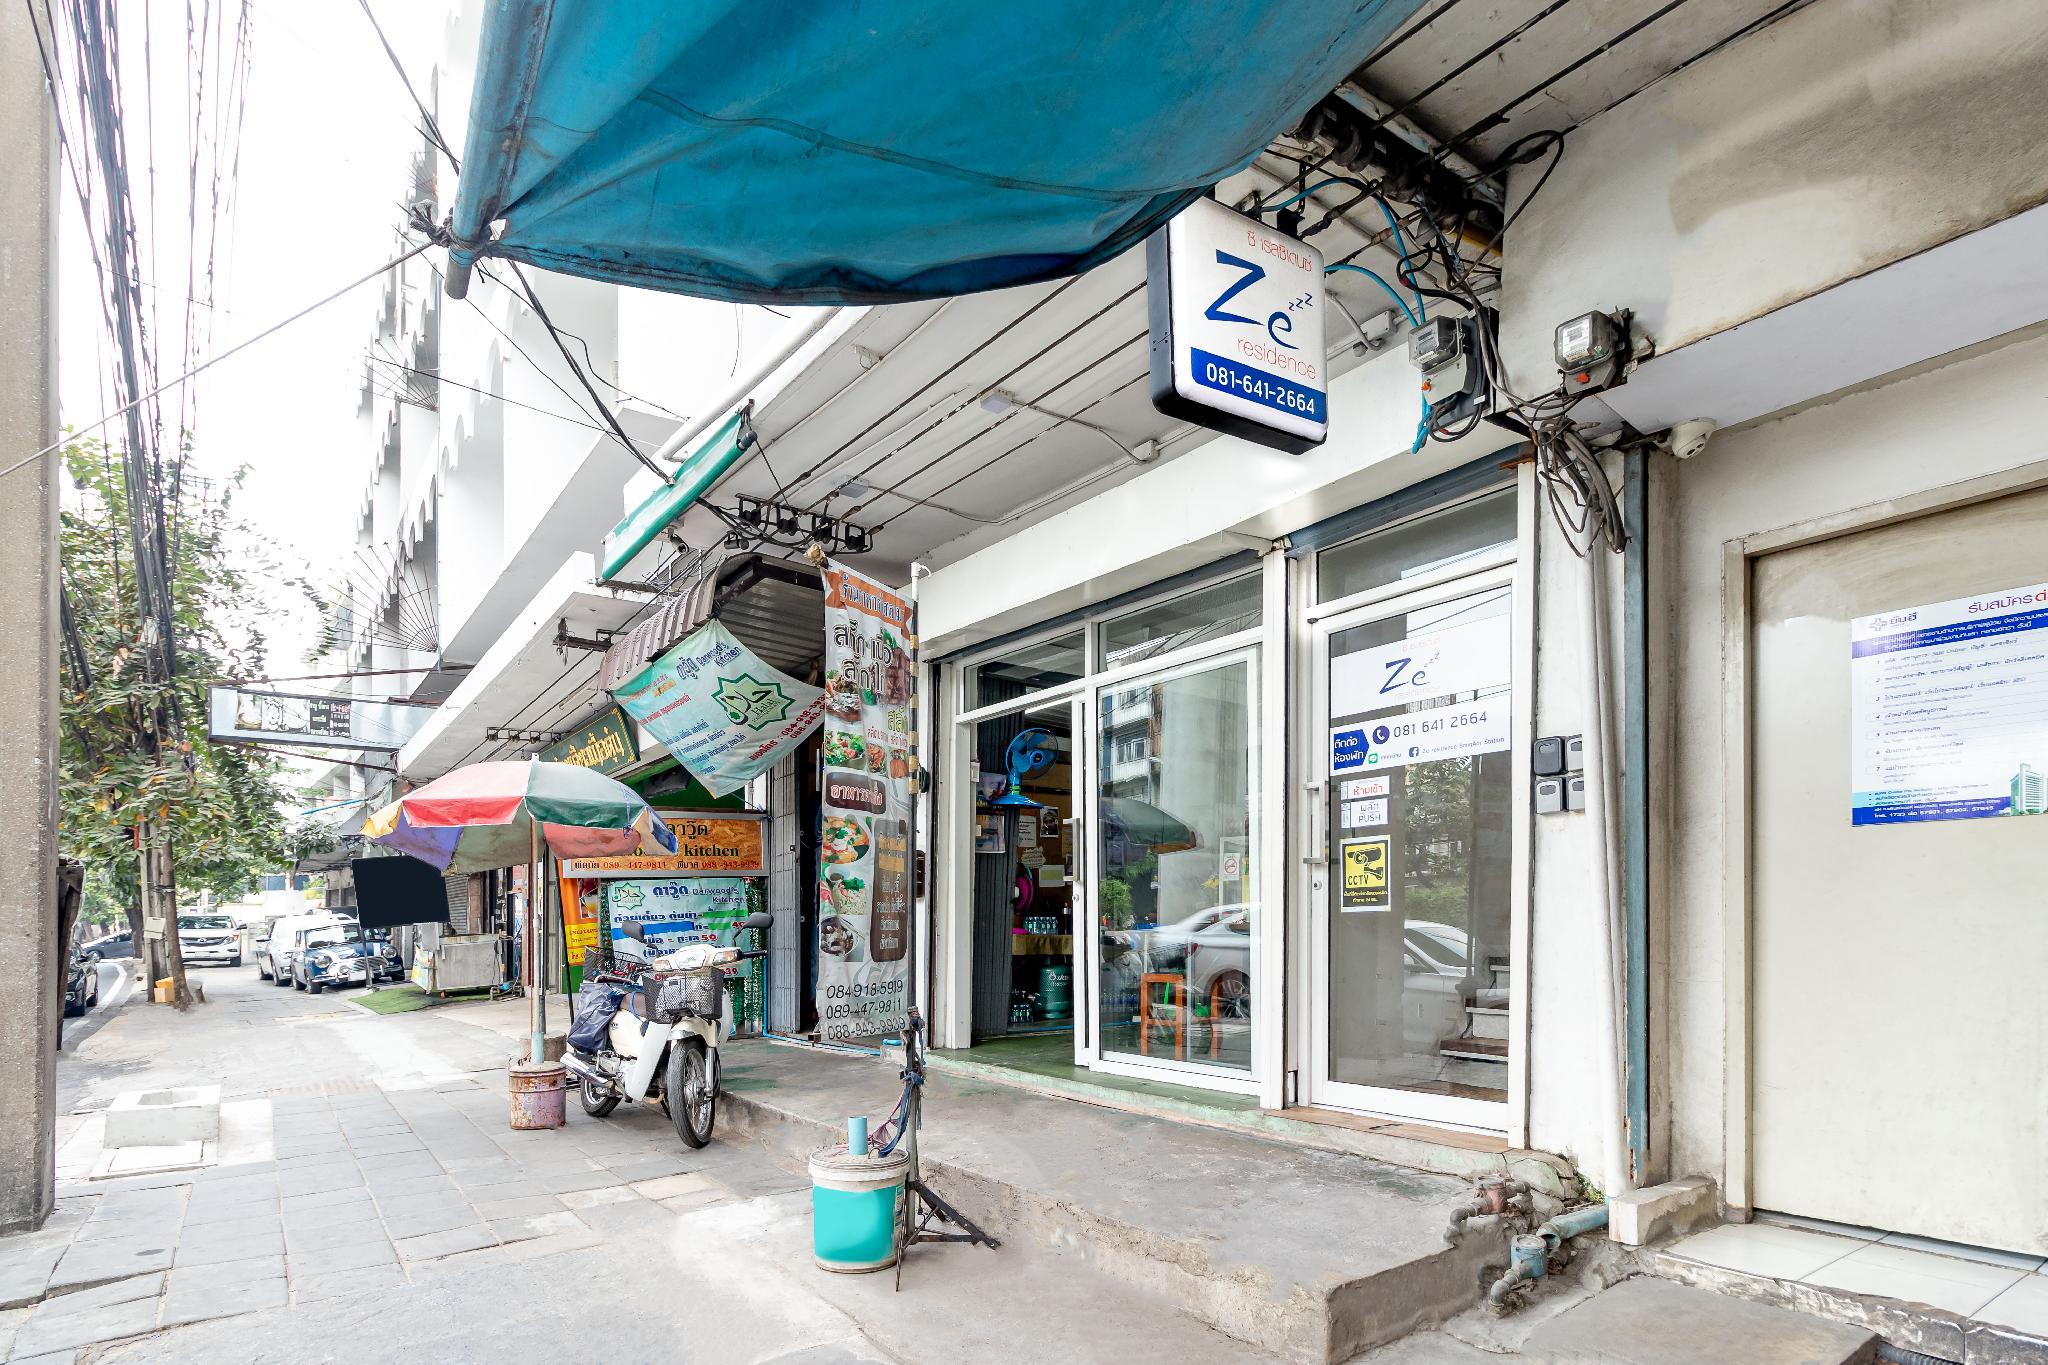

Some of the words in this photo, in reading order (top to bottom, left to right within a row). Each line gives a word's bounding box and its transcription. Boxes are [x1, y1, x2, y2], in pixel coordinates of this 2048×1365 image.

[1236, 337, 1317, 380] residence
[1206, 362, 1316, 415] 081-641-2664
[1968, 593, 2033, 615] รับสมัคร
[713, 645, 743, 669] Kitchen
[1393, 723, 1416, 738] 081
[1421, 717, 1445, 733] 641
[1450, 711, 1488, 729] 2664
[1333, 736, 1359, 750] ติดต่อ
[1333, 748, 1365, 763] ห้องพัก
[1353, 784, 1384, 796] ห้ามเข้า
[1358, 812, 1381, 823] PUSH
[684, 846, 739, 858] kitchen
[1347, 873, 1370, 886] CCTV
[712, 895, 746, 905] Kitchen
[701, 933, 718, 942] 50
